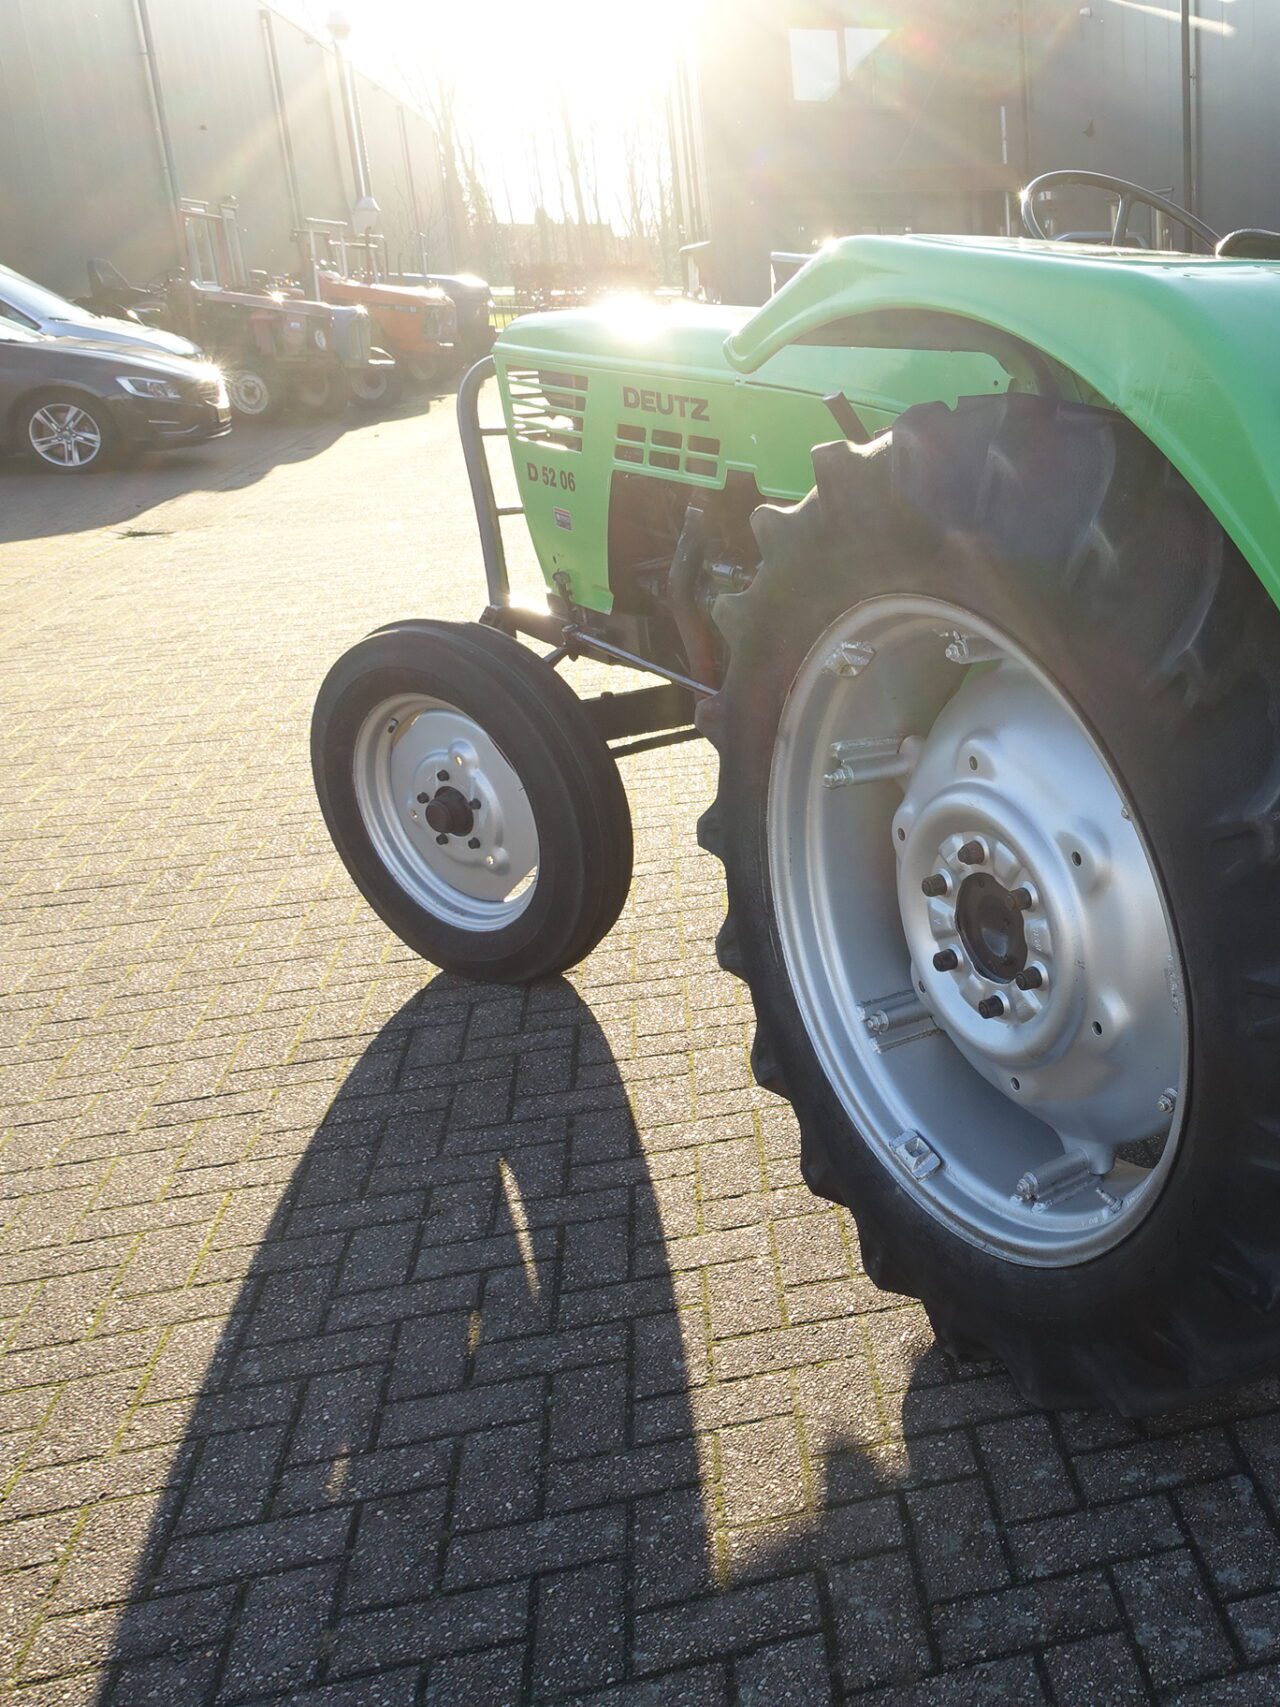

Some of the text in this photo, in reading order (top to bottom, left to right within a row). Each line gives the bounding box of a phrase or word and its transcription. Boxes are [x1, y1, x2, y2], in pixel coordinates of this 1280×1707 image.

[623, 385, 710, 422] DEUTZ
[526, 462, 576, 492] D 52 06
